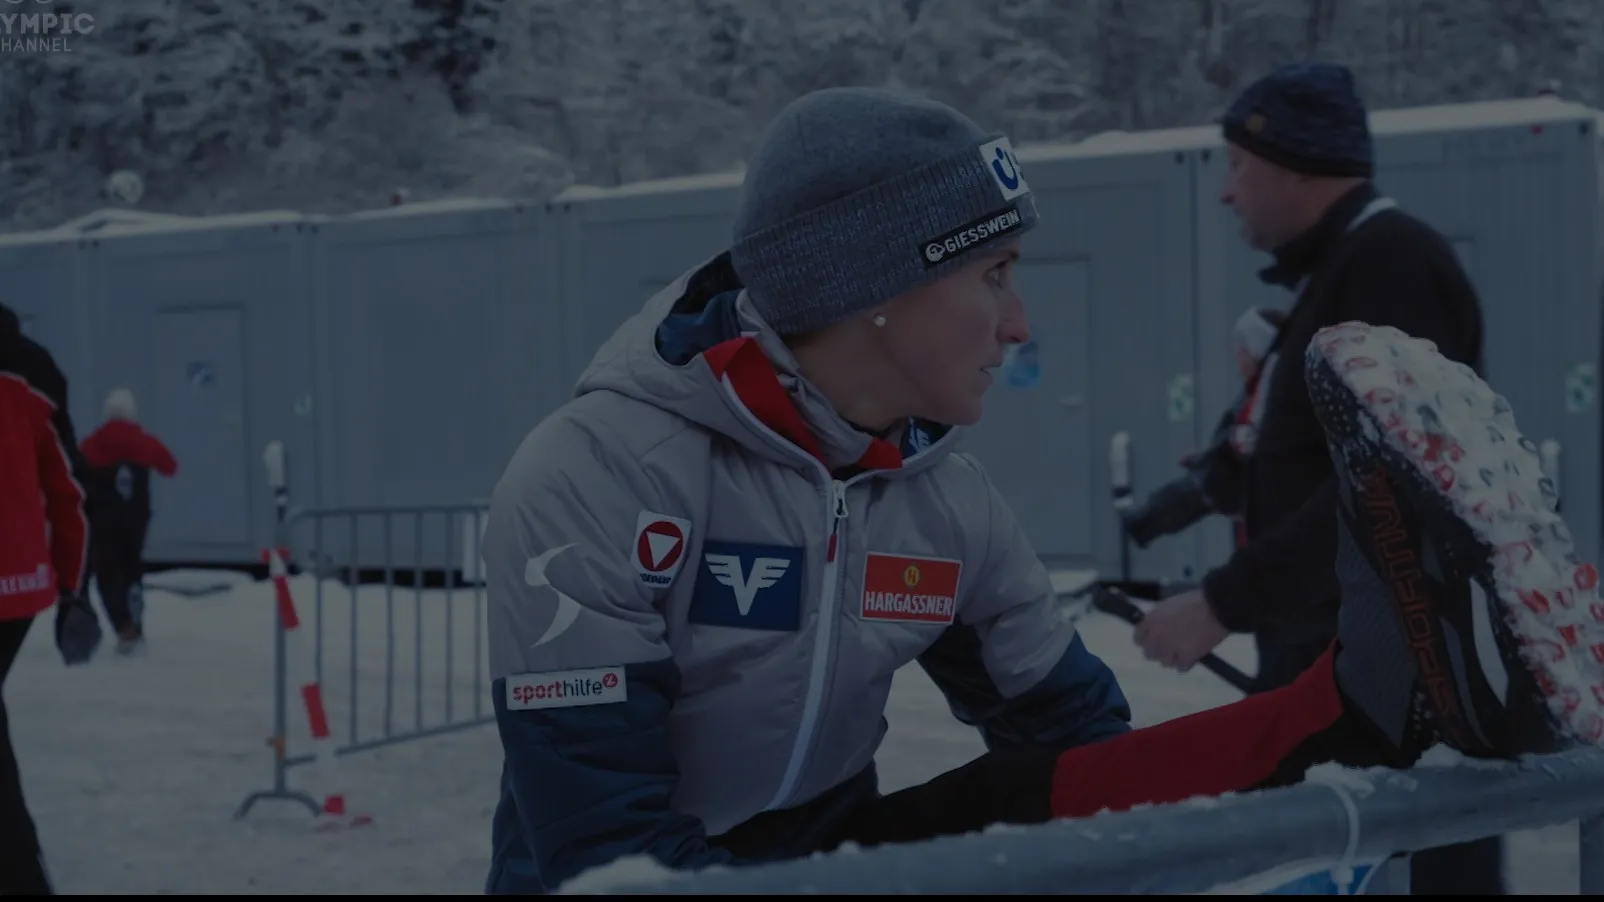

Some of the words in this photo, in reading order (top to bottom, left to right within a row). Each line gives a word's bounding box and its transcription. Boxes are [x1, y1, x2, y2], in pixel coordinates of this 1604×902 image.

[945, 209, 1020, 252] GIESSWEIN
[865, 591, 953, 616] HARGASSNER
[513, 679, 603, 704] sporthilfe
